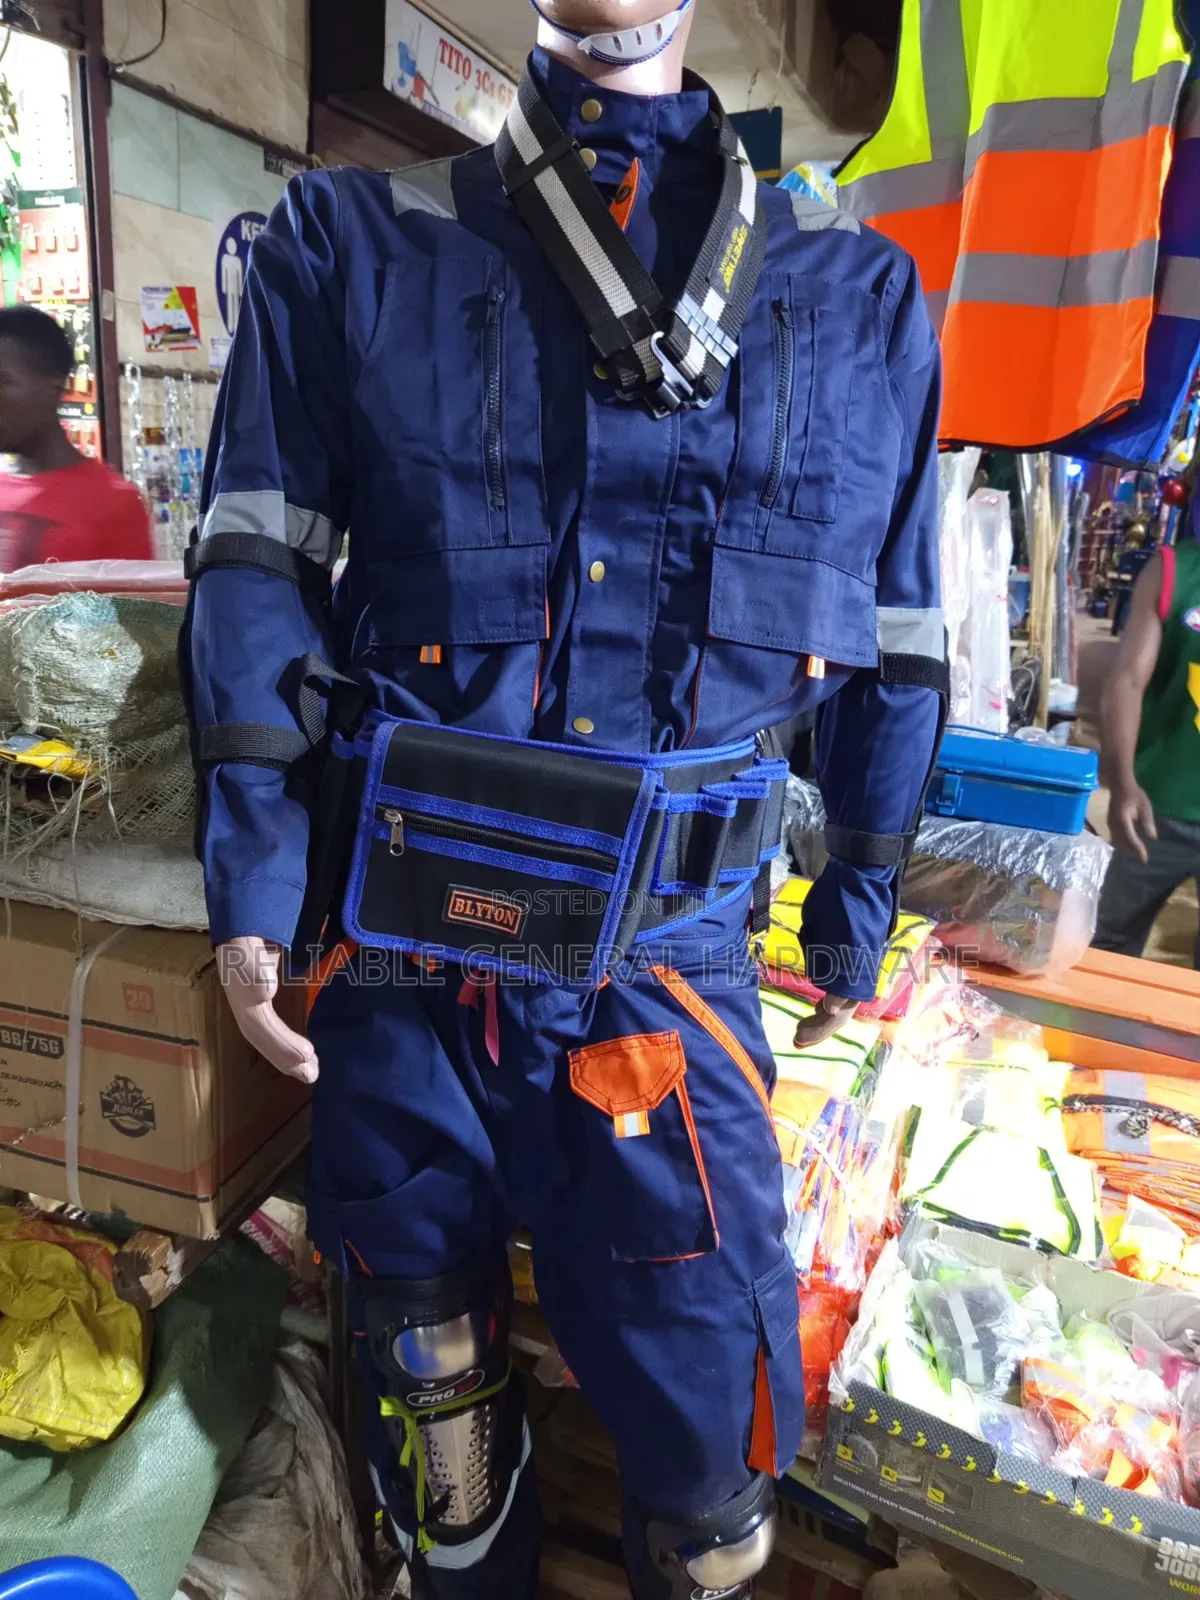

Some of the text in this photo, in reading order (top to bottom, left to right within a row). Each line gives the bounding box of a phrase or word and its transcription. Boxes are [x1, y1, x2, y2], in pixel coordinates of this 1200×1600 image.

[439, 37, 472, 81] TITO
[241, 219, 266, 241] KE
[453, 898, 516, 927] BLYTON
[1154, 1552, 1200, 1582] JOG
